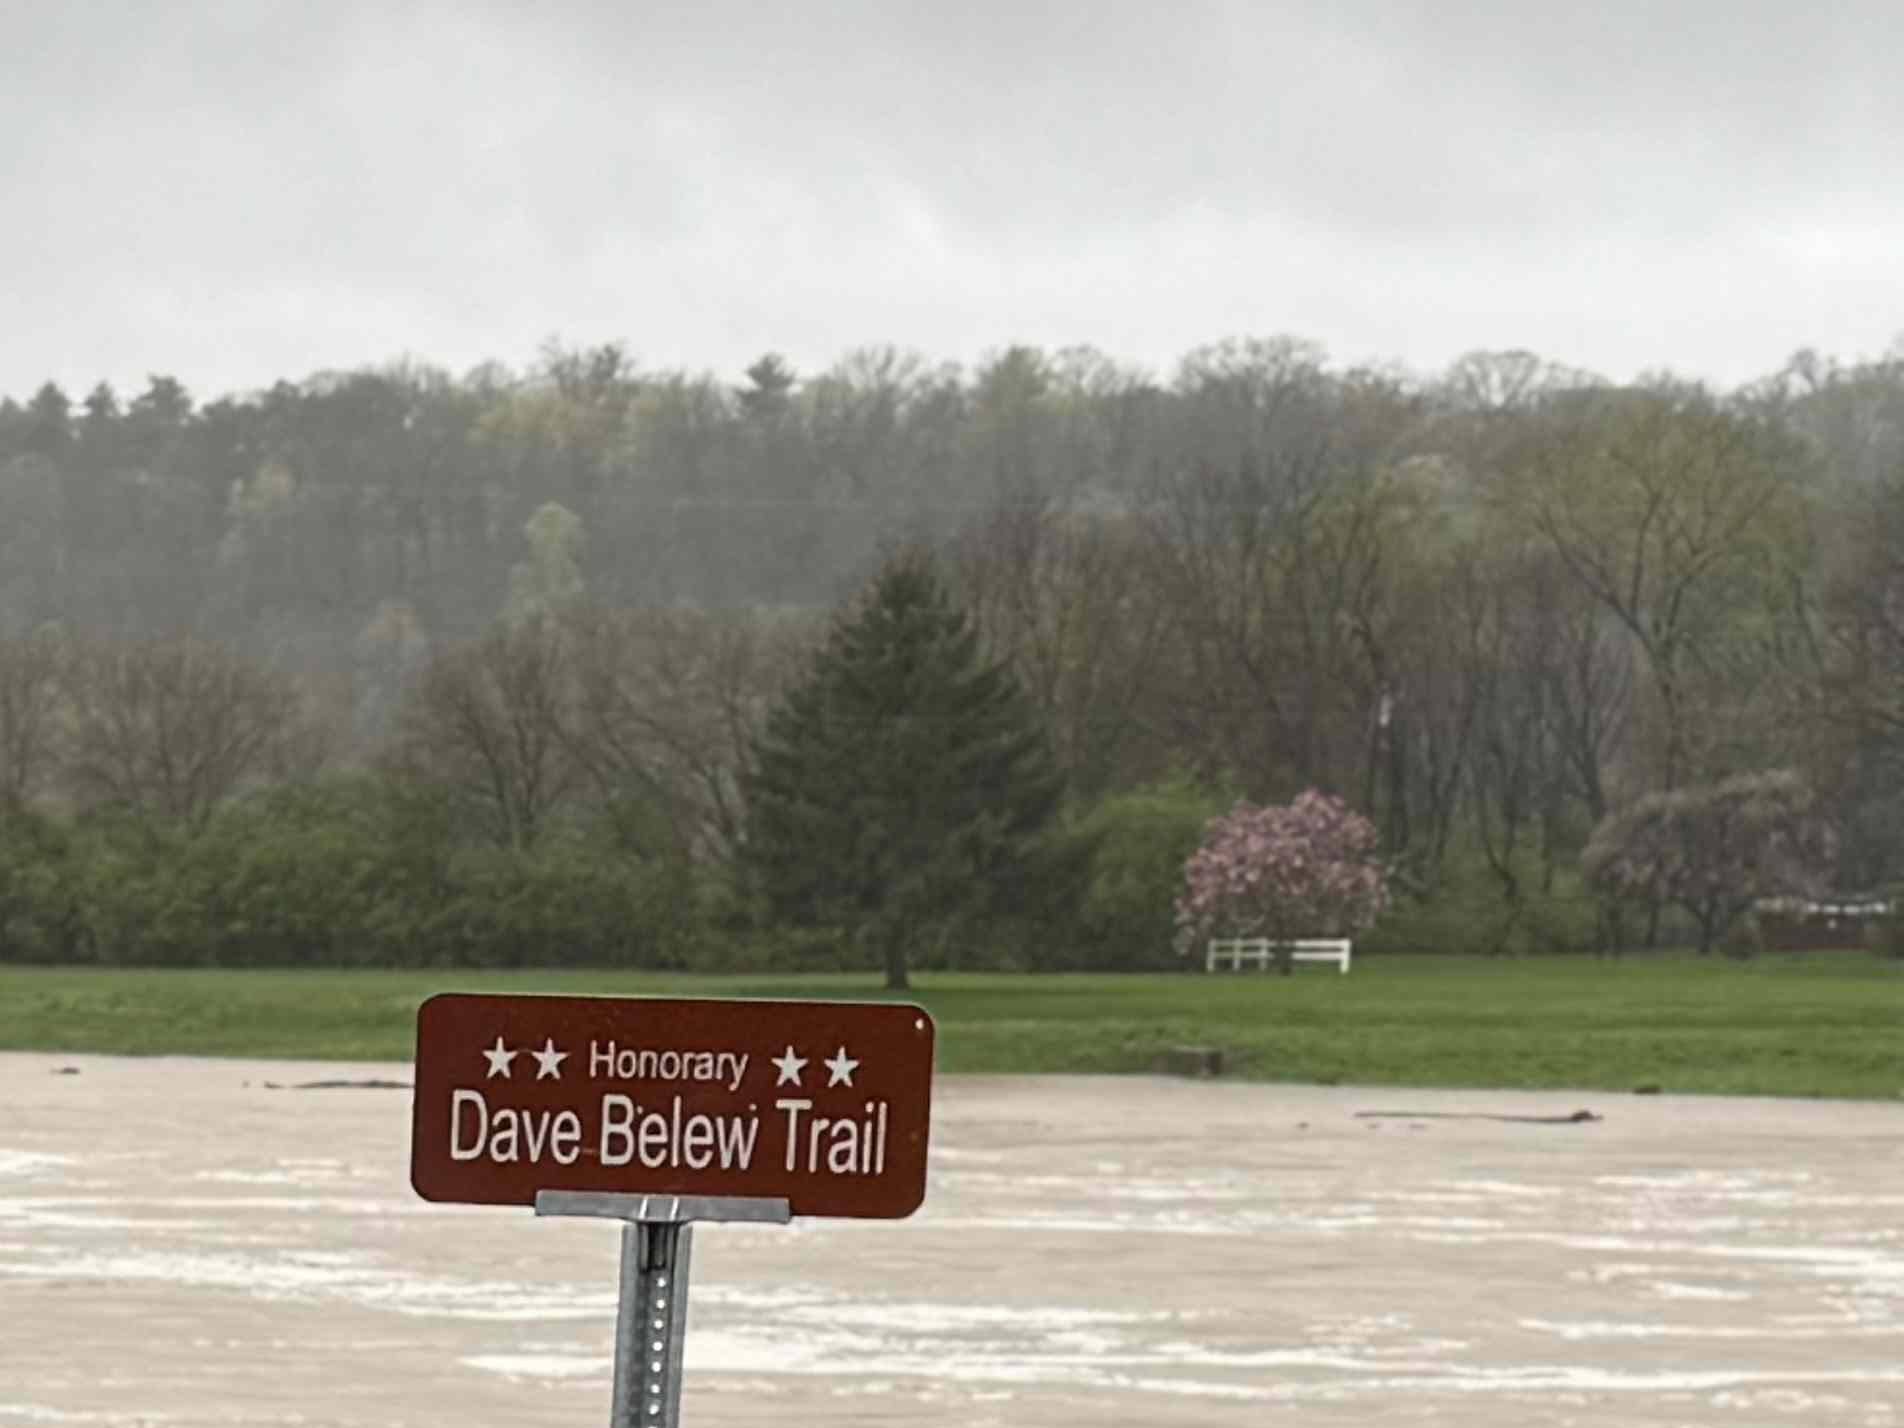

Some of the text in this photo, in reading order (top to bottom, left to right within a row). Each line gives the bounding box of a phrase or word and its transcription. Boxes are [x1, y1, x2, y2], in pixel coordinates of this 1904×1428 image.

[589, 1040, 749, 1091] Honorary
[450, 1089, 888, 1174] Dave Belew Trail
